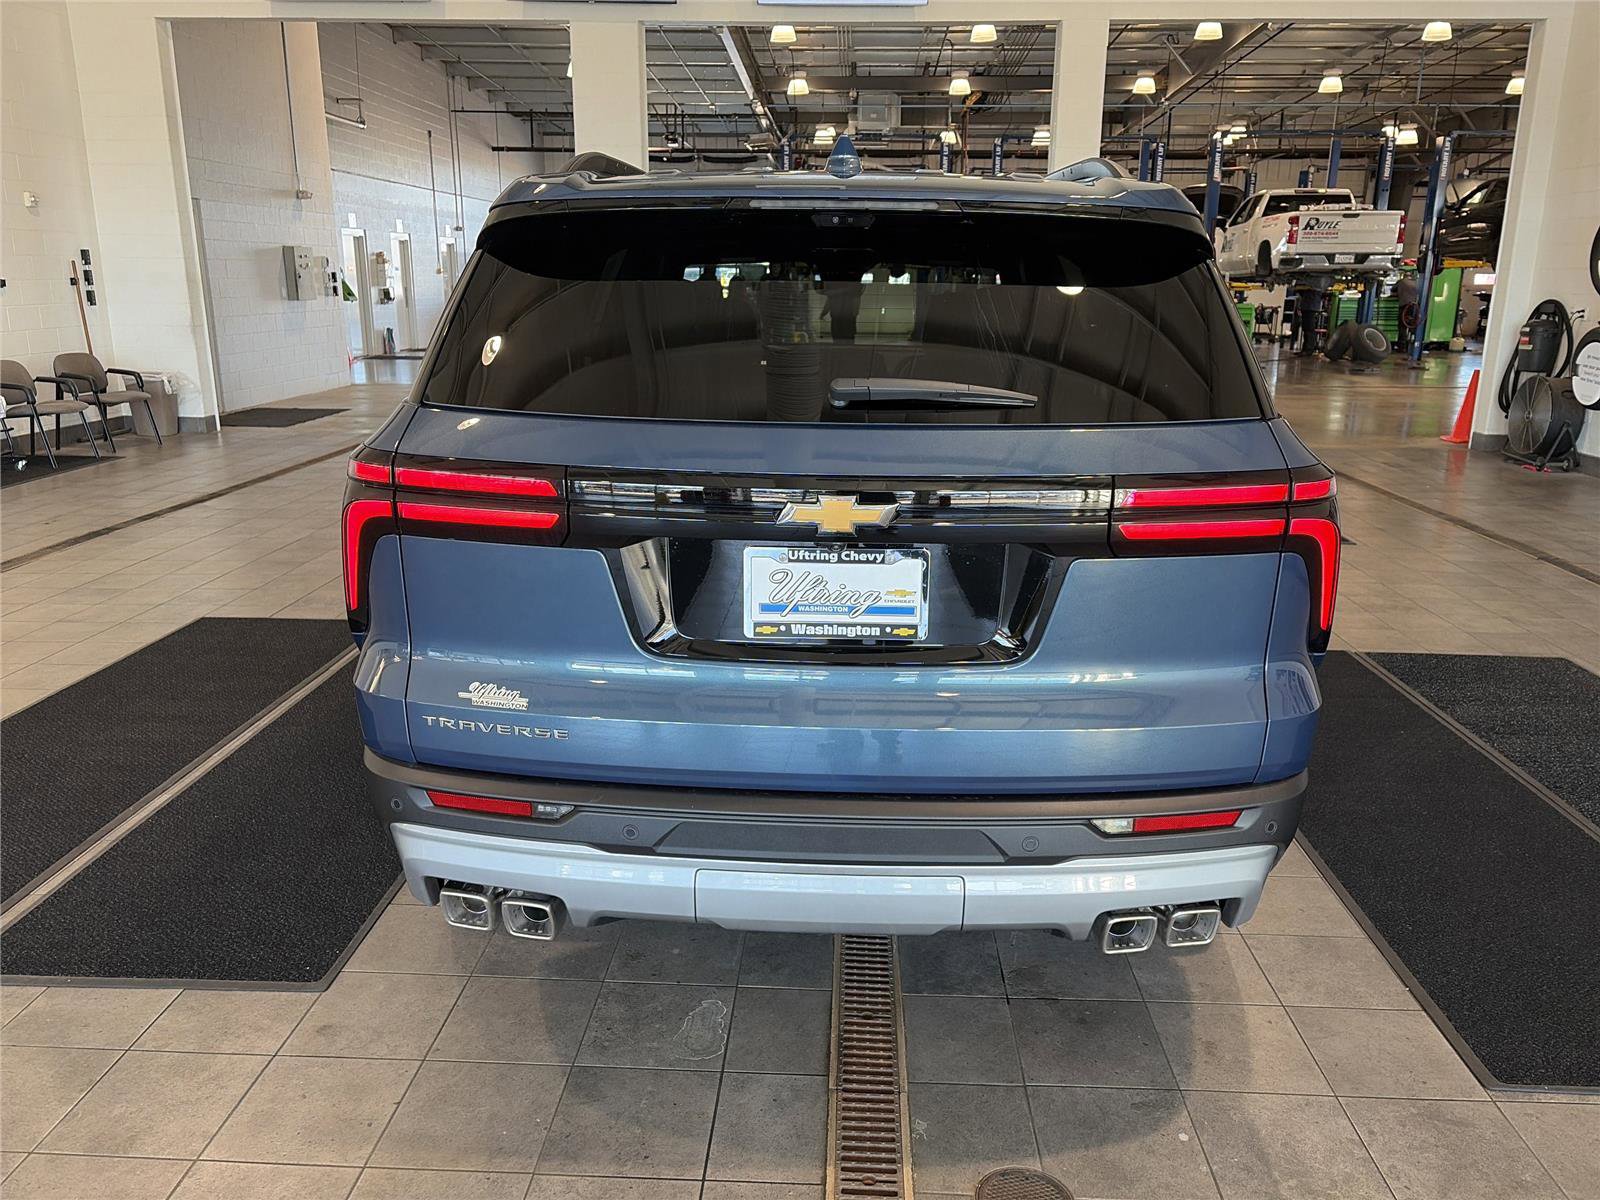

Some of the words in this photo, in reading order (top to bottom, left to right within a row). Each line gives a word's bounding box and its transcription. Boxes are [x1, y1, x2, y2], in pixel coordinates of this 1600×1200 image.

[1387, 137, 1395, 151] LIFT
[1444, 137, 1452, 151] LIFT
[1156, 156, 1164, 181] ROTARY
[1213, 152, 1221, 178] ROTARY
[1383, 152, 1393, 177] ROTARY
[1440, 152, 1450, 177] ROTARY
[788, 550, 839, 562] Uftring
[841, 551, 884, 563] Chevy
[769, 568, 882, 619] Uftring
[797, 605, 849, 613] WASHINGTON
[790, 623, 881, 637] Washington
[472, 699, 529, 710] WASHINGTON
[422, 715, 569, 740] TRAVERSE
